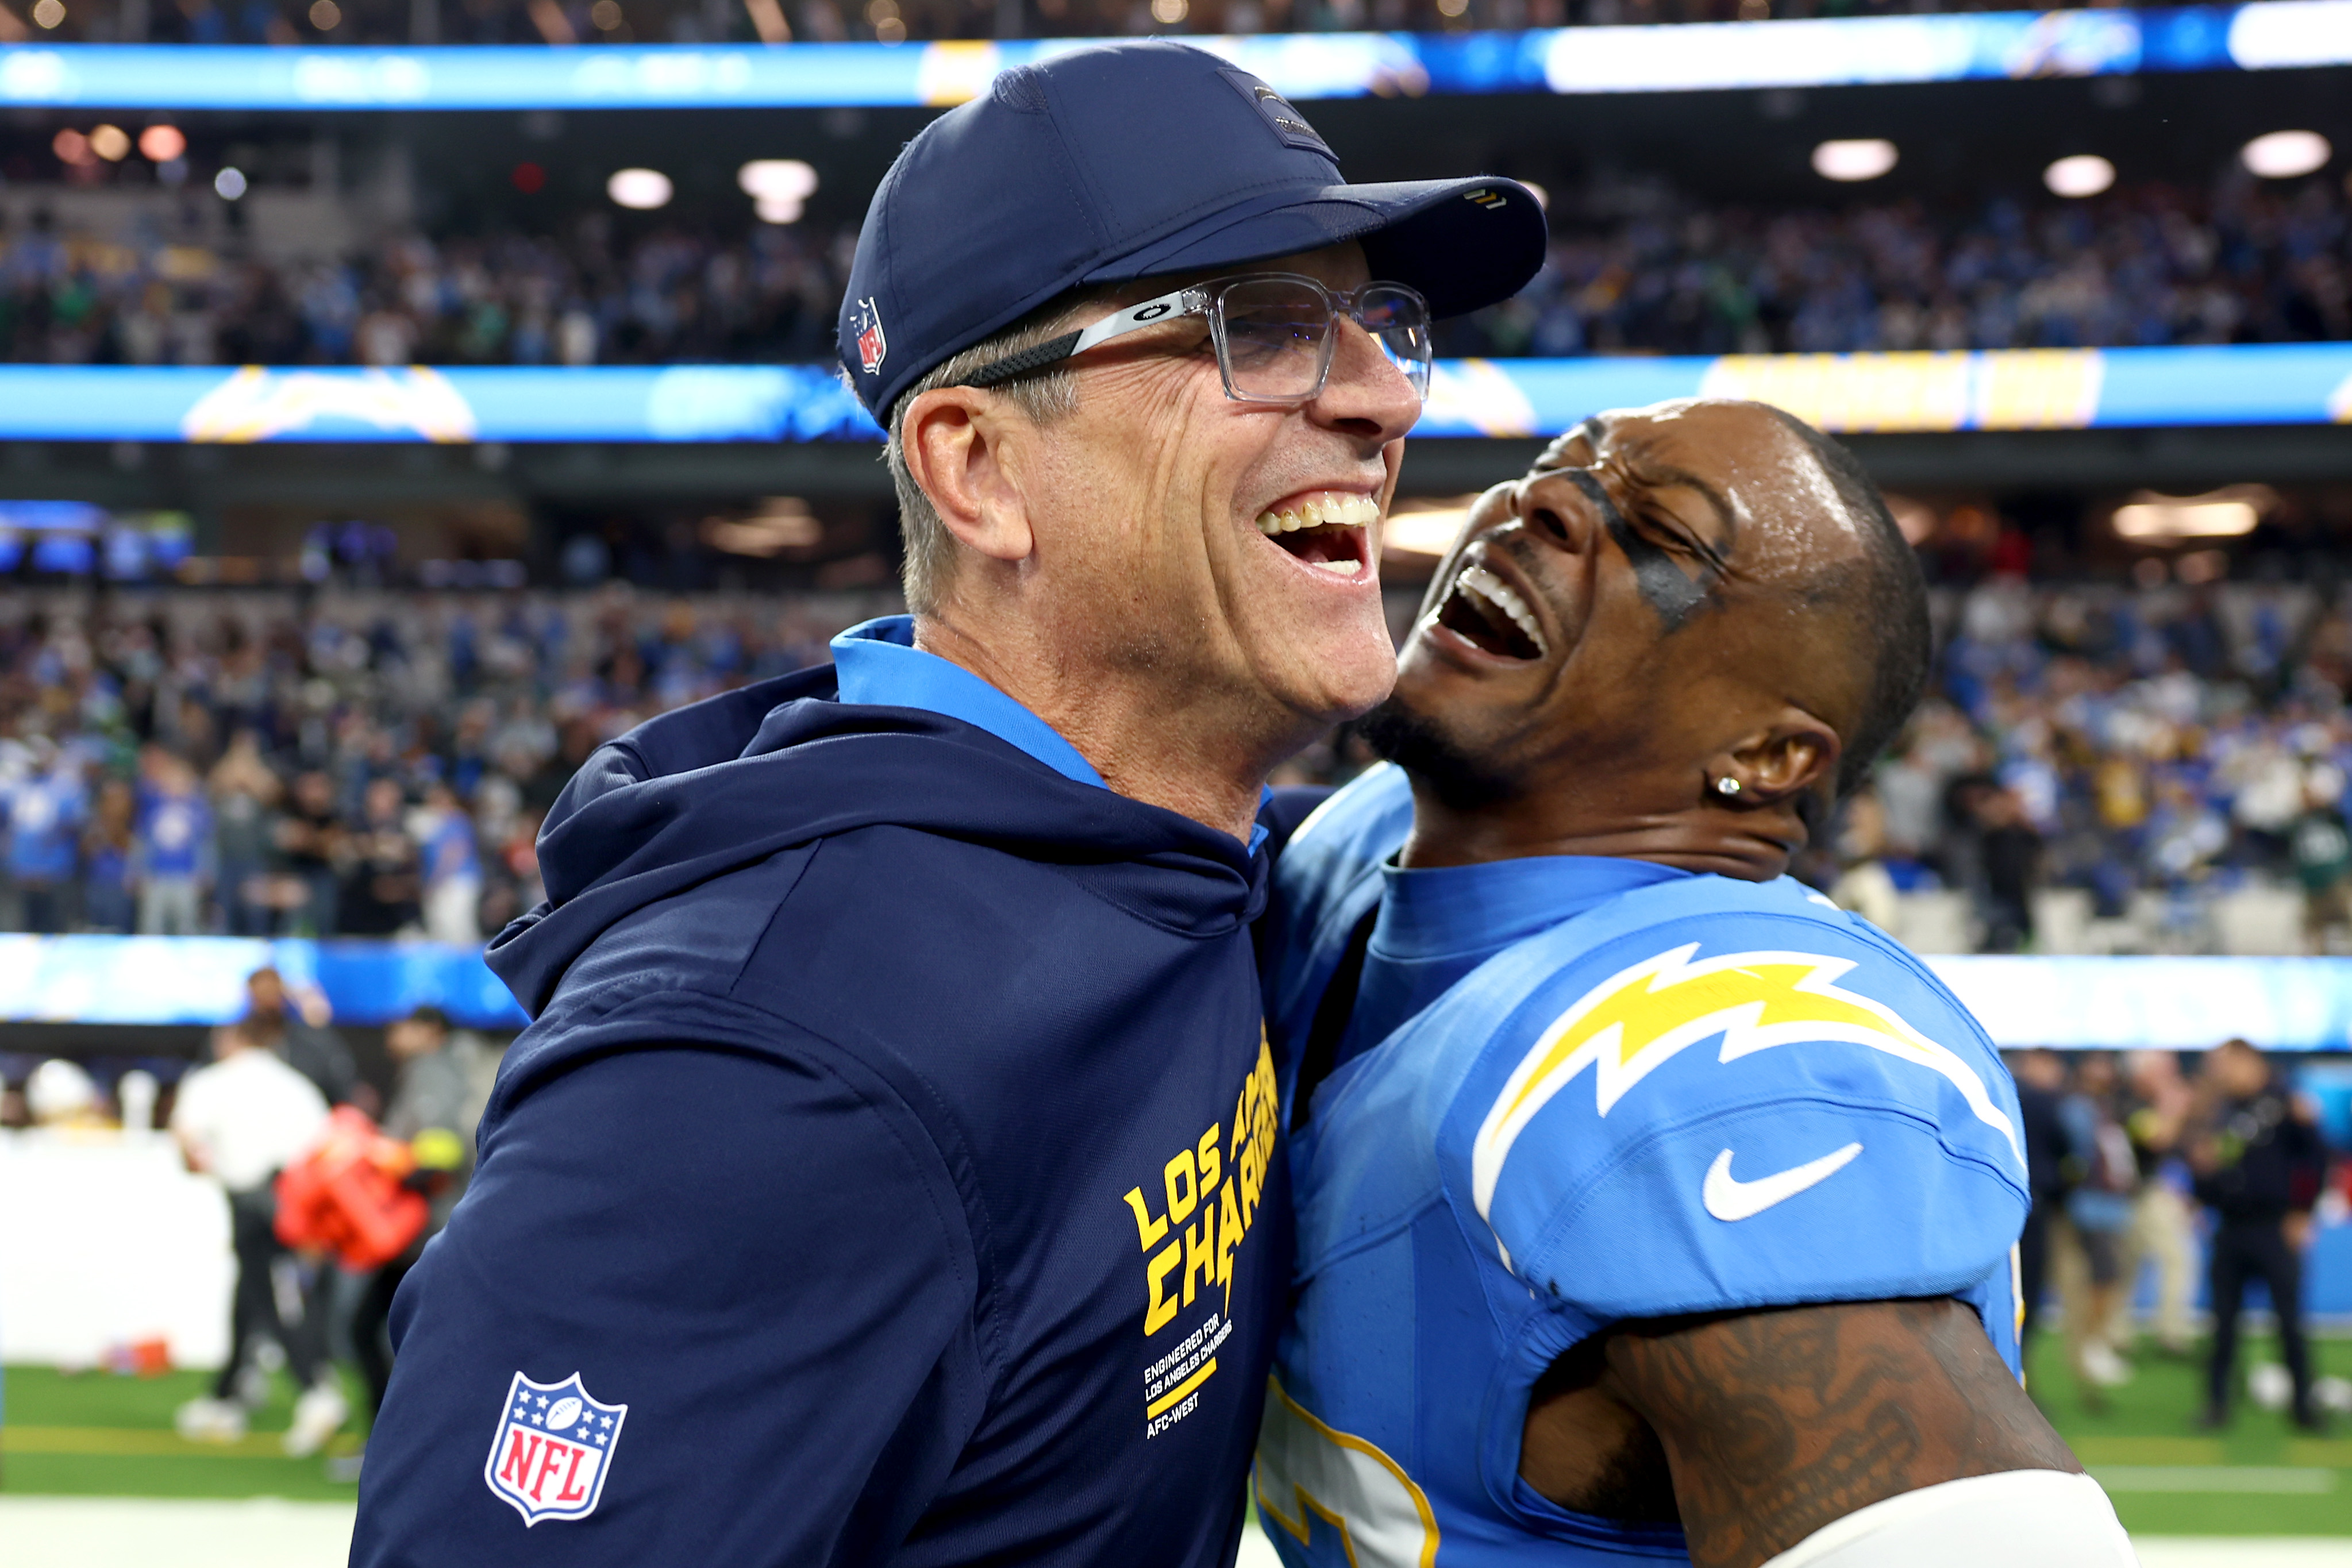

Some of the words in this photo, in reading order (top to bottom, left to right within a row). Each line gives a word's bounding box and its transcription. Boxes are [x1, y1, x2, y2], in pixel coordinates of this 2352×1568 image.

[858, 327, 882, 364] NFL
[1123, 1122, 1221, 1253] LOS
[1144, 1095, 1279, 1336] CHARG
[1144, 1328, 1204, 1385] ENGINEERED
[1203, 1312, 1219, 1339] FOR
[1145, 1380, 1162, 1402] LOS
[1165, 1352, 1200, 1390] ANGELES
[1200, 1319, 1233, 1361] CHARGERS
[1147, 1391, 1199, 1439] AFC-WEST
[500, 1429, 585, 1502] NFL
